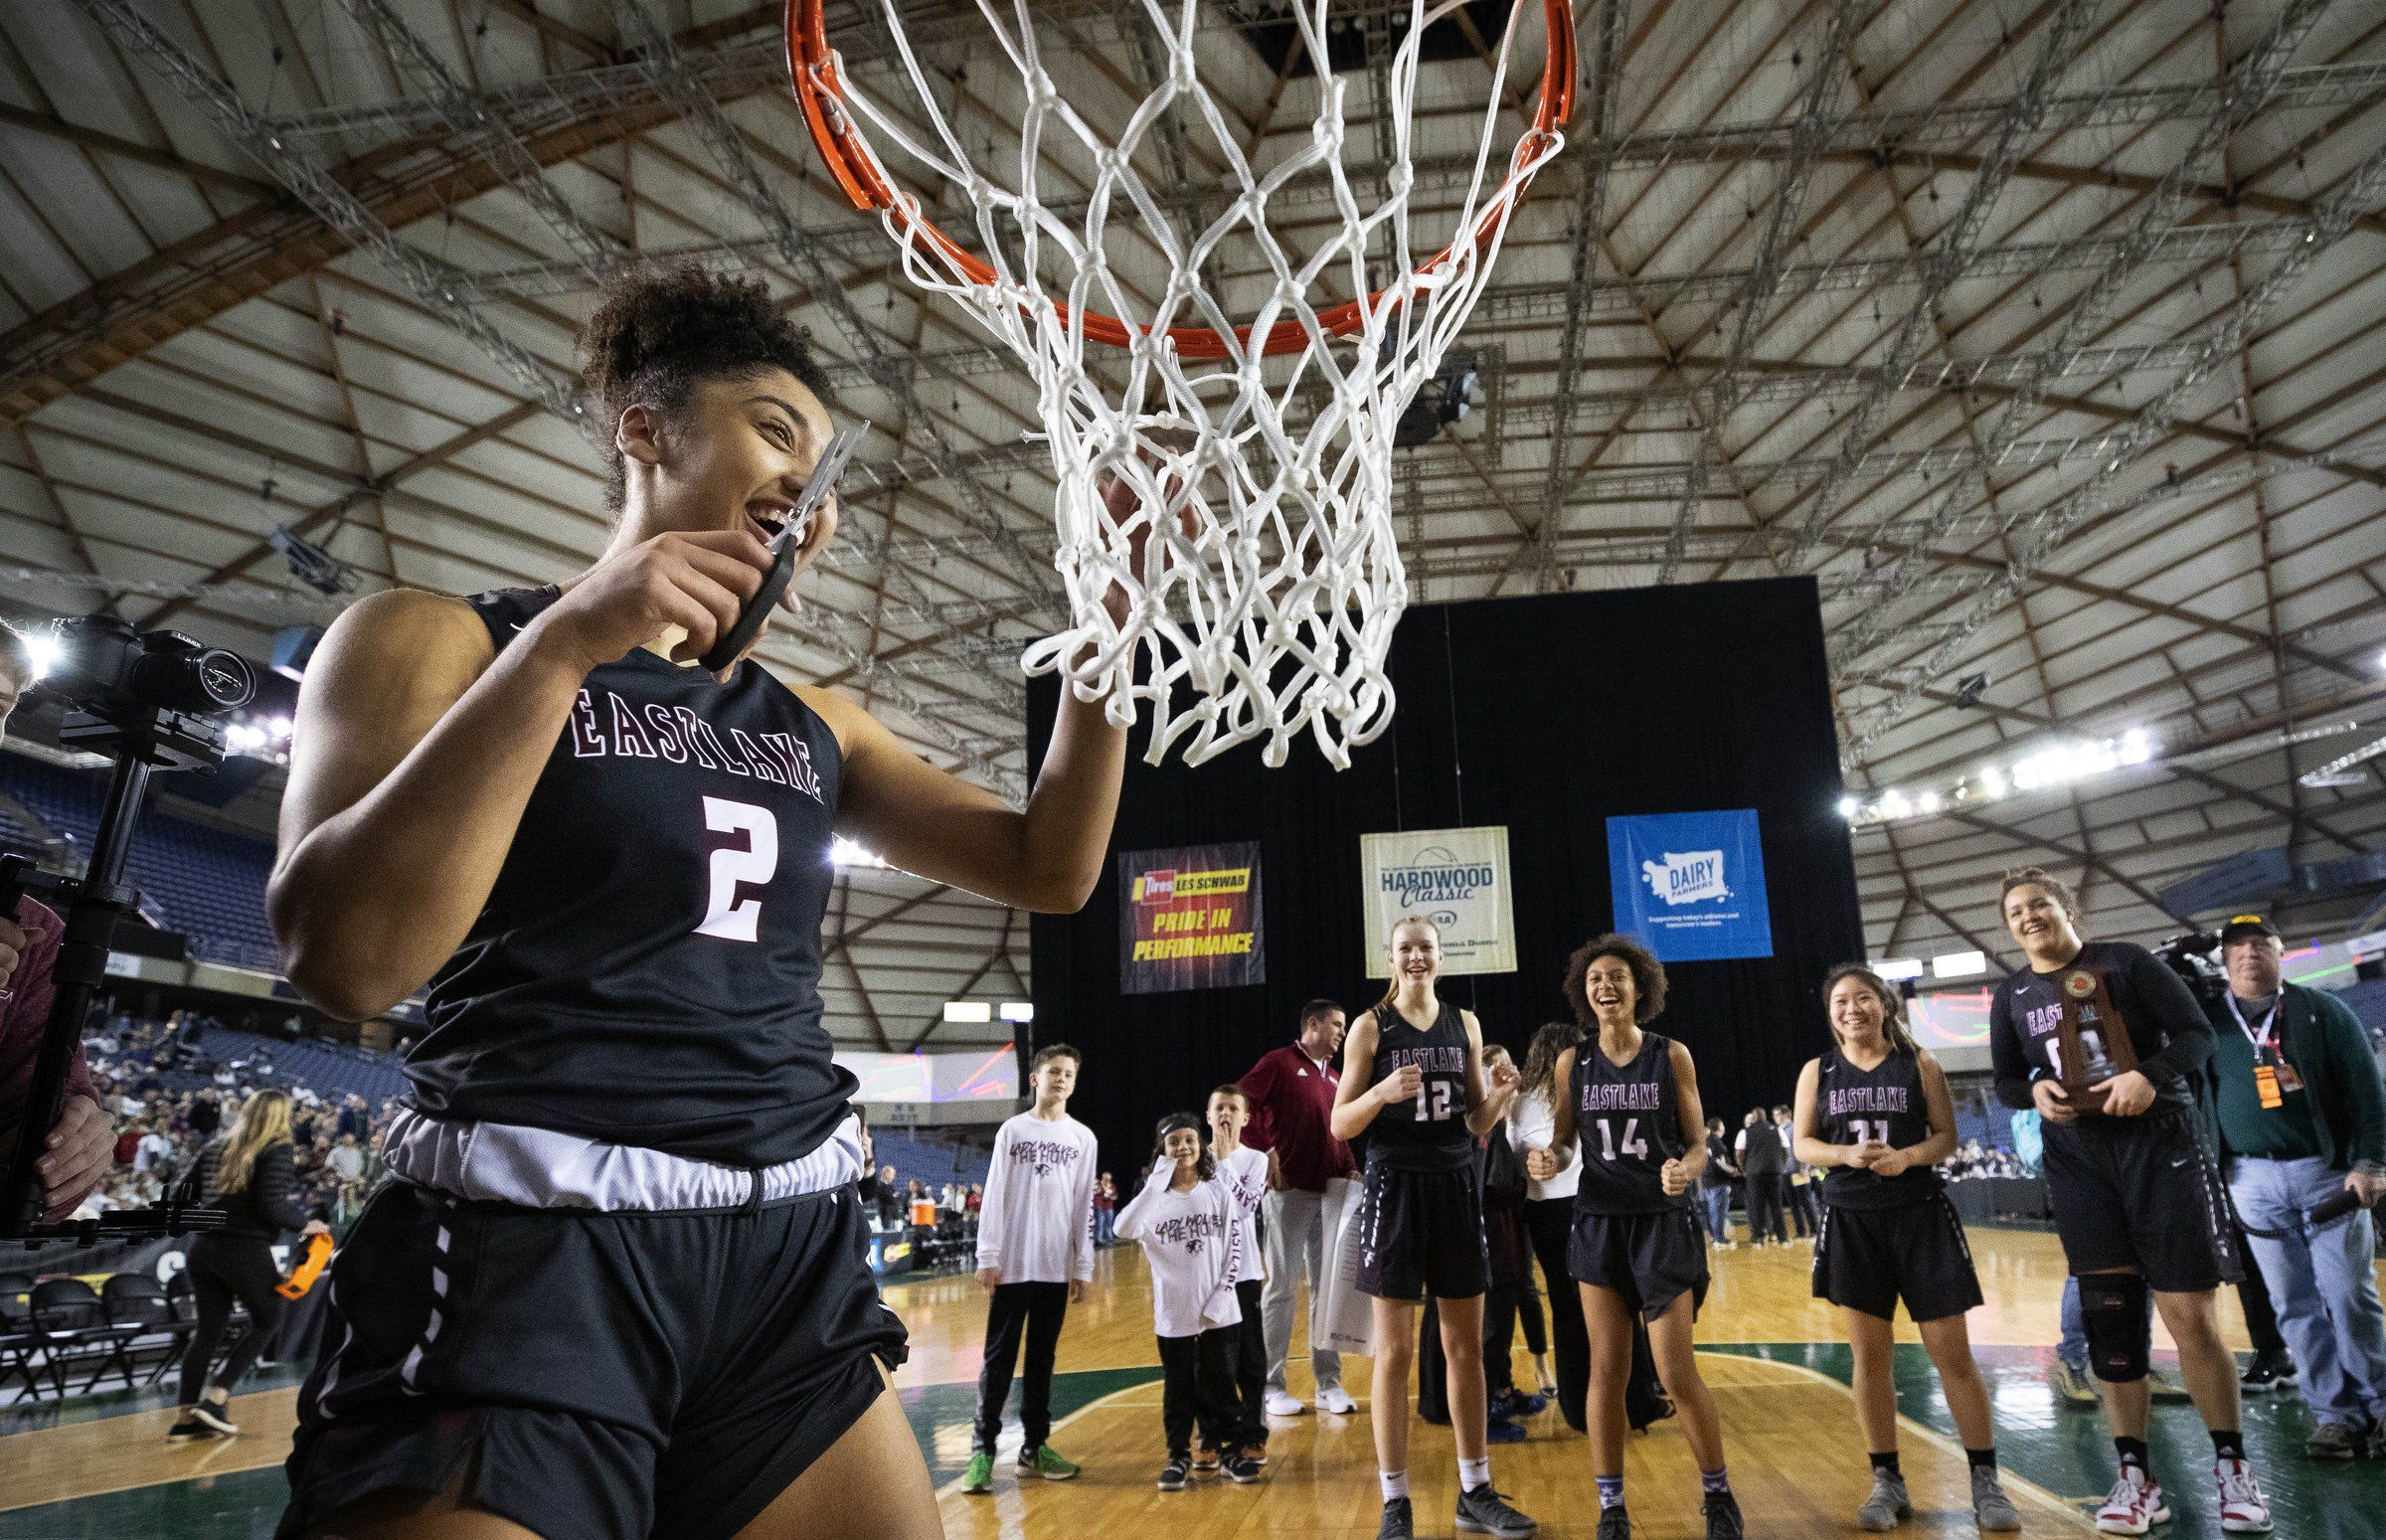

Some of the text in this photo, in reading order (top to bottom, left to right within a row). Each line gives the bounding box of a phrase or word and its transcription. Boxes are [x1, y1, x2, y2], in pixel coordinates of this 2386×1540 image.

[177, 632, 202, 649] LUMIX
[571, 688, 825, 805] EASTLAKE
[692, 795, 779, 942] 2
[1382, 868, 1492, 891] HARDWOOD
[1670, 857, 1714, 889] DAIRY
[1176, 875, 1245, 891] LES SCHWAB
[1671, 881, 1713, 898] FARMERS
[1401, 887, 1475, 909] Classic
[1153, 909, 1232, 933] PRIDE IN
[1132, 933, 1254, 961] PERFORMANCE
[2026, 1003, 2065, 1037] EAST
[1392, 1046, 1464, 1073] EASTLAKE
[1416, 1080, 1451, 1122] 12
[1582, 1083, 1660, 1112] EASTLAKE
[1829, 1087, 1908, 1115] EASTLAKE
[1596, 1117, 1648, 1161] 14
[1155, 1216, 1184, 1235] LADY
